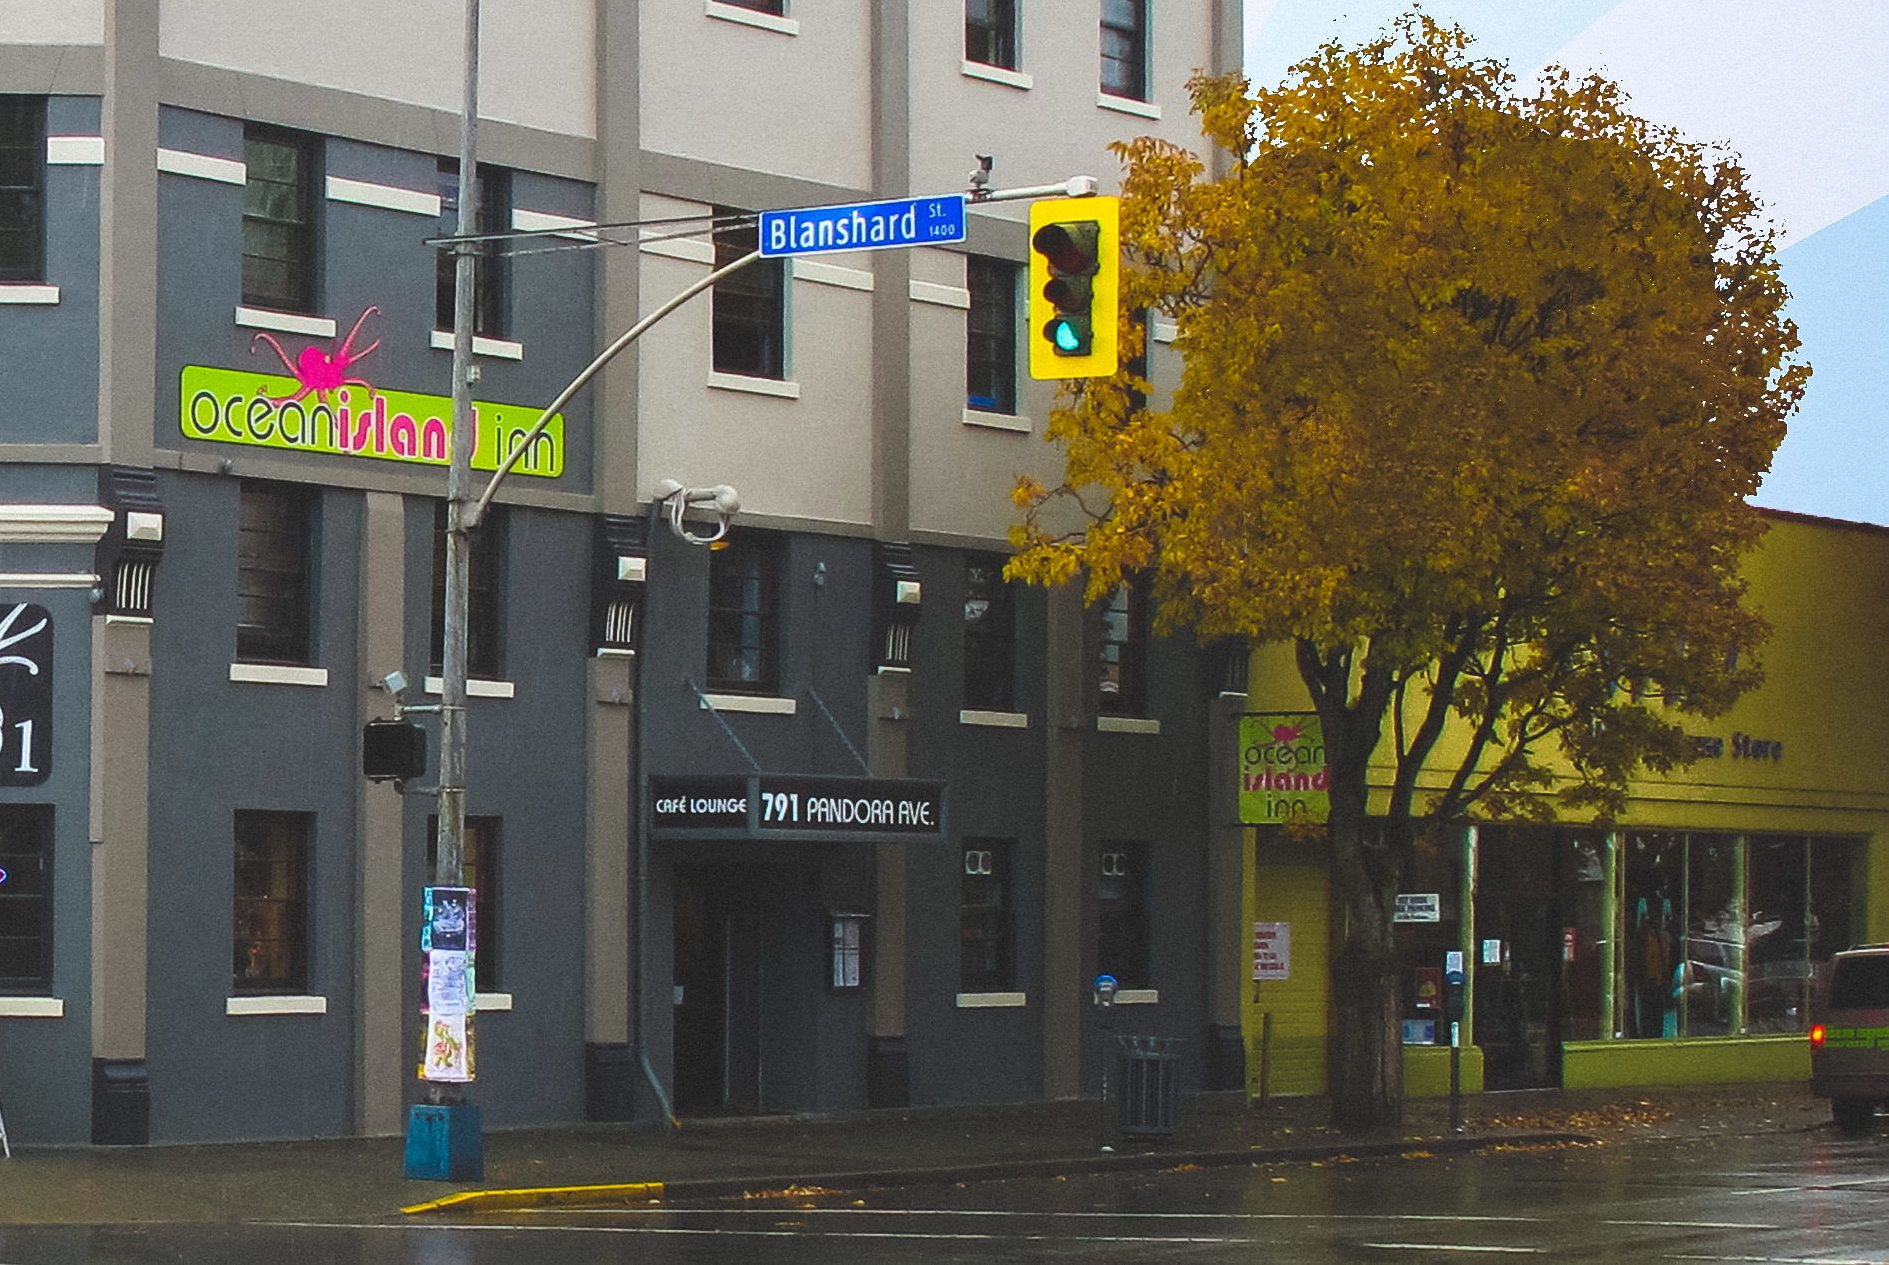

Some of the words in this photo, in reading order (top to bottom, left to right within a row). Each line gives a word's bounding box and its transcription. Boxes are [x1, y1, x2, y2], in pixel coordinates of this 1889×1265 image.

[770, 202, 917, 250] Blanshard
[928, 202, 947, 219] St.
[929, 224, 956, 237] 1400
[496, 414, 554, 472] inn
[1243, 765, 1331, 792] island
[656, 796, 686, 813] CAFÉ
[690, 798, 747, 814] LOUNGE
[762, 792, 798, 822] 791
[807, 797, 894, 825] PANDORA
[898, 800, 935, 826] AVE.
[1266, 792, 1310, 817] inn
